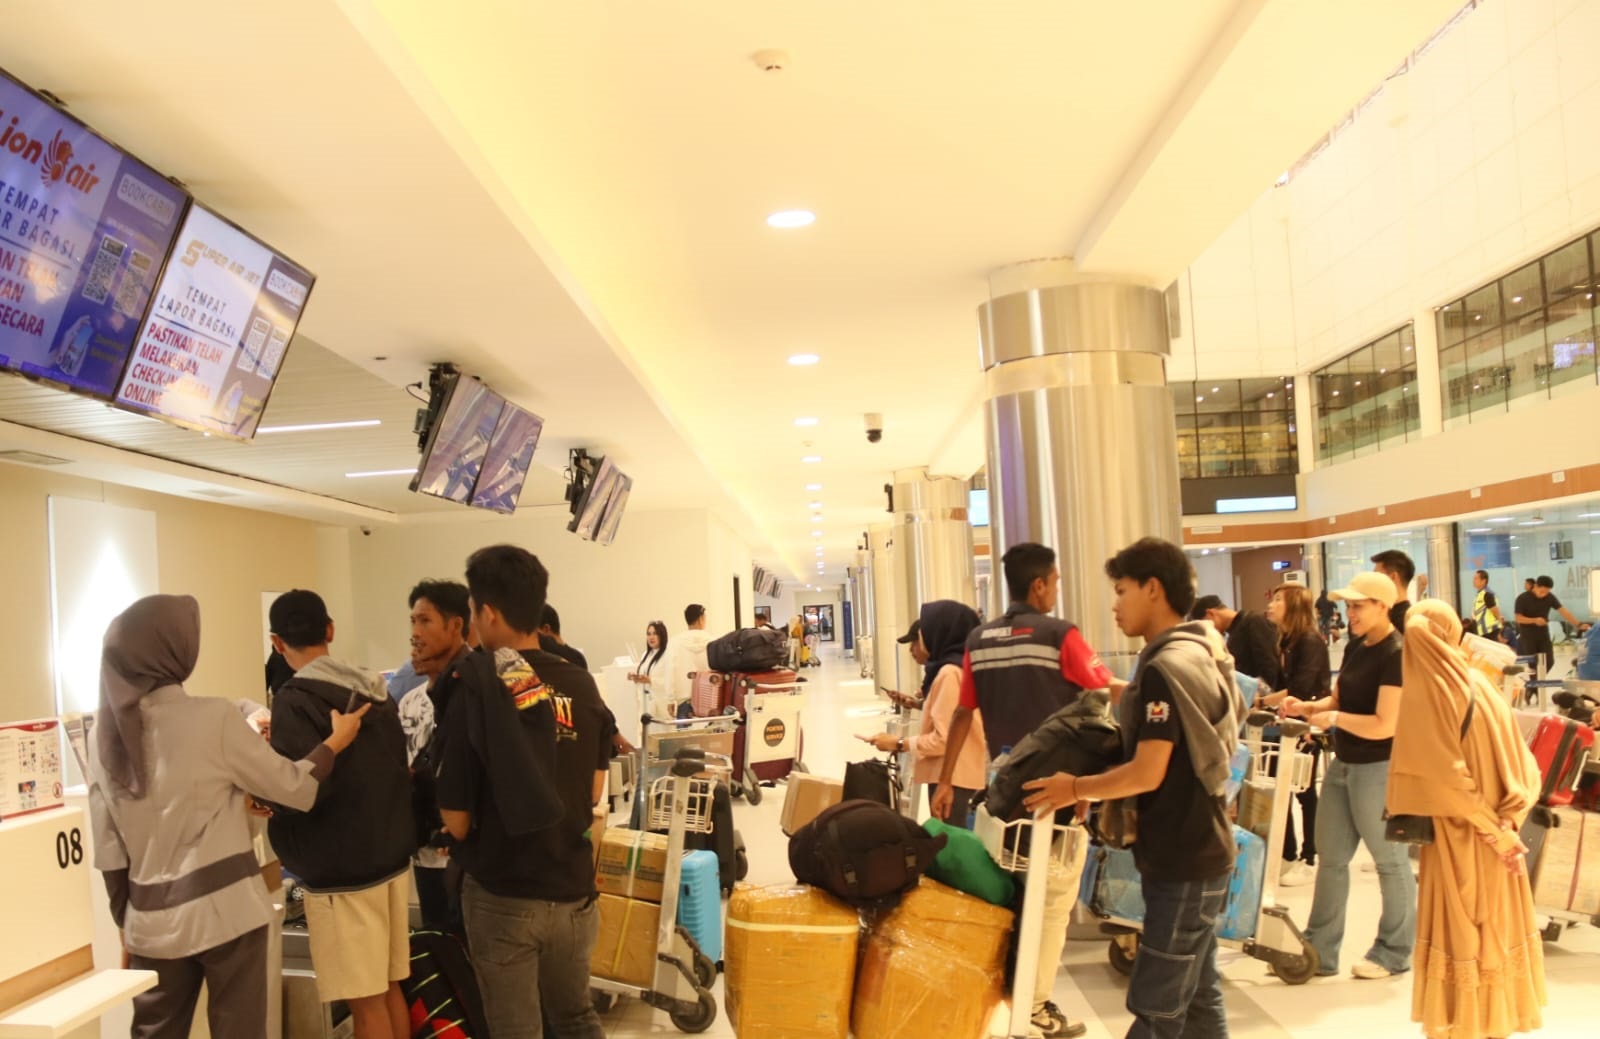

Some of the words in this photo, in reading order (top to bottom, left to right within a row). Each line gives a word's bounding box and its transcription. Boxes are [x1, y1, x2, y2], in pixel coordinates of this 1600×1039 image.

[0, 109, 43, 165] ion
[66, 163, 99, 194] air
[18, 219, 76, 260] BAGASI
[159, 294, 196, 322] LAPOR
[198, 312, 236, 338] BAGASI
[186, 286, 228, 314] TEMPAT
[147, 322, 194, 353] PASTIKAN
[56, 827, 83, 869] 08
